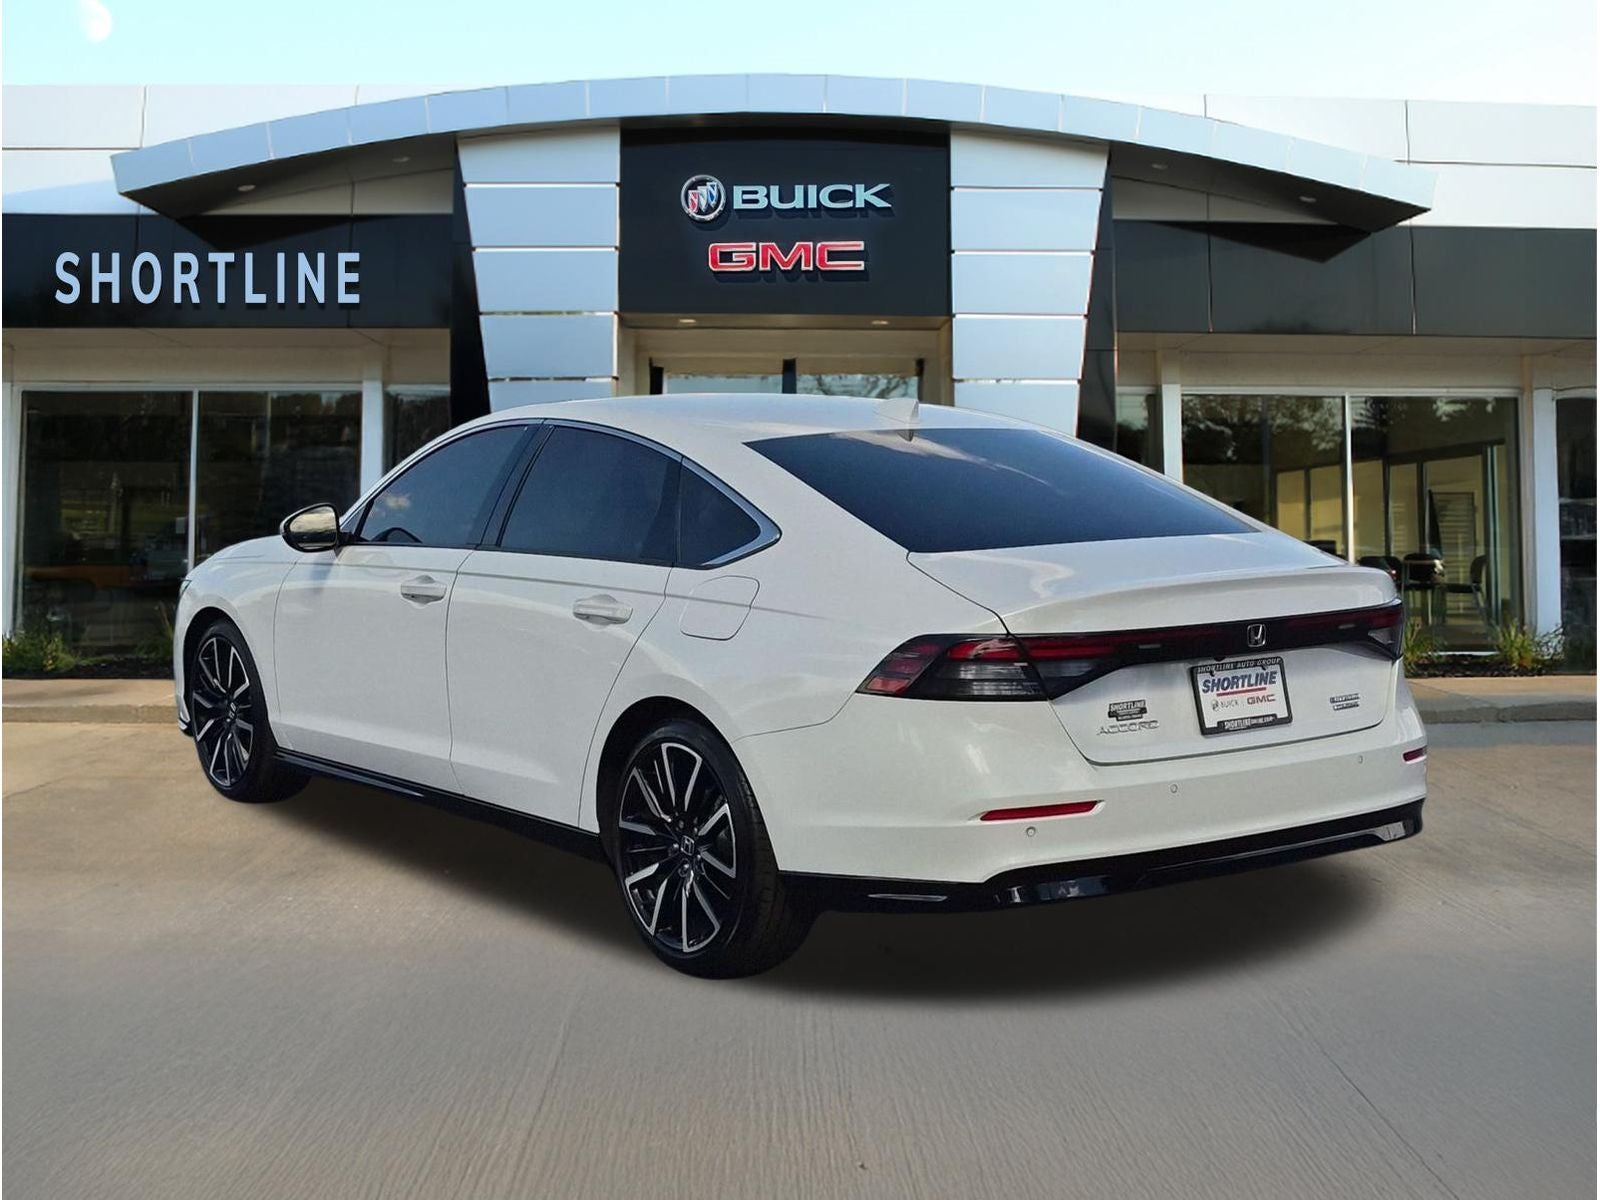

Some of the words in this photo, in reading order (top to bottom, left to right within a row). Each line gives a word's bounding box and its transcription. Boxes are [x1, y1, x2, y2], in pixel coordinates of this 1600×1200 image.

[733, 183, 892, 209] BUICK
[708, 241, 865, 271] GMC
[55, 252, 360, 304] SHORTLINE
[1237, 661, 1254, 669] AUTO
[1257, 657, 1281, 666] GROUP
[1202, 671, 1277, 694] SHORTLINE
[1246, 694, 1276, 705] GMC
[1097, 720, 1160, 735] ACCORD
